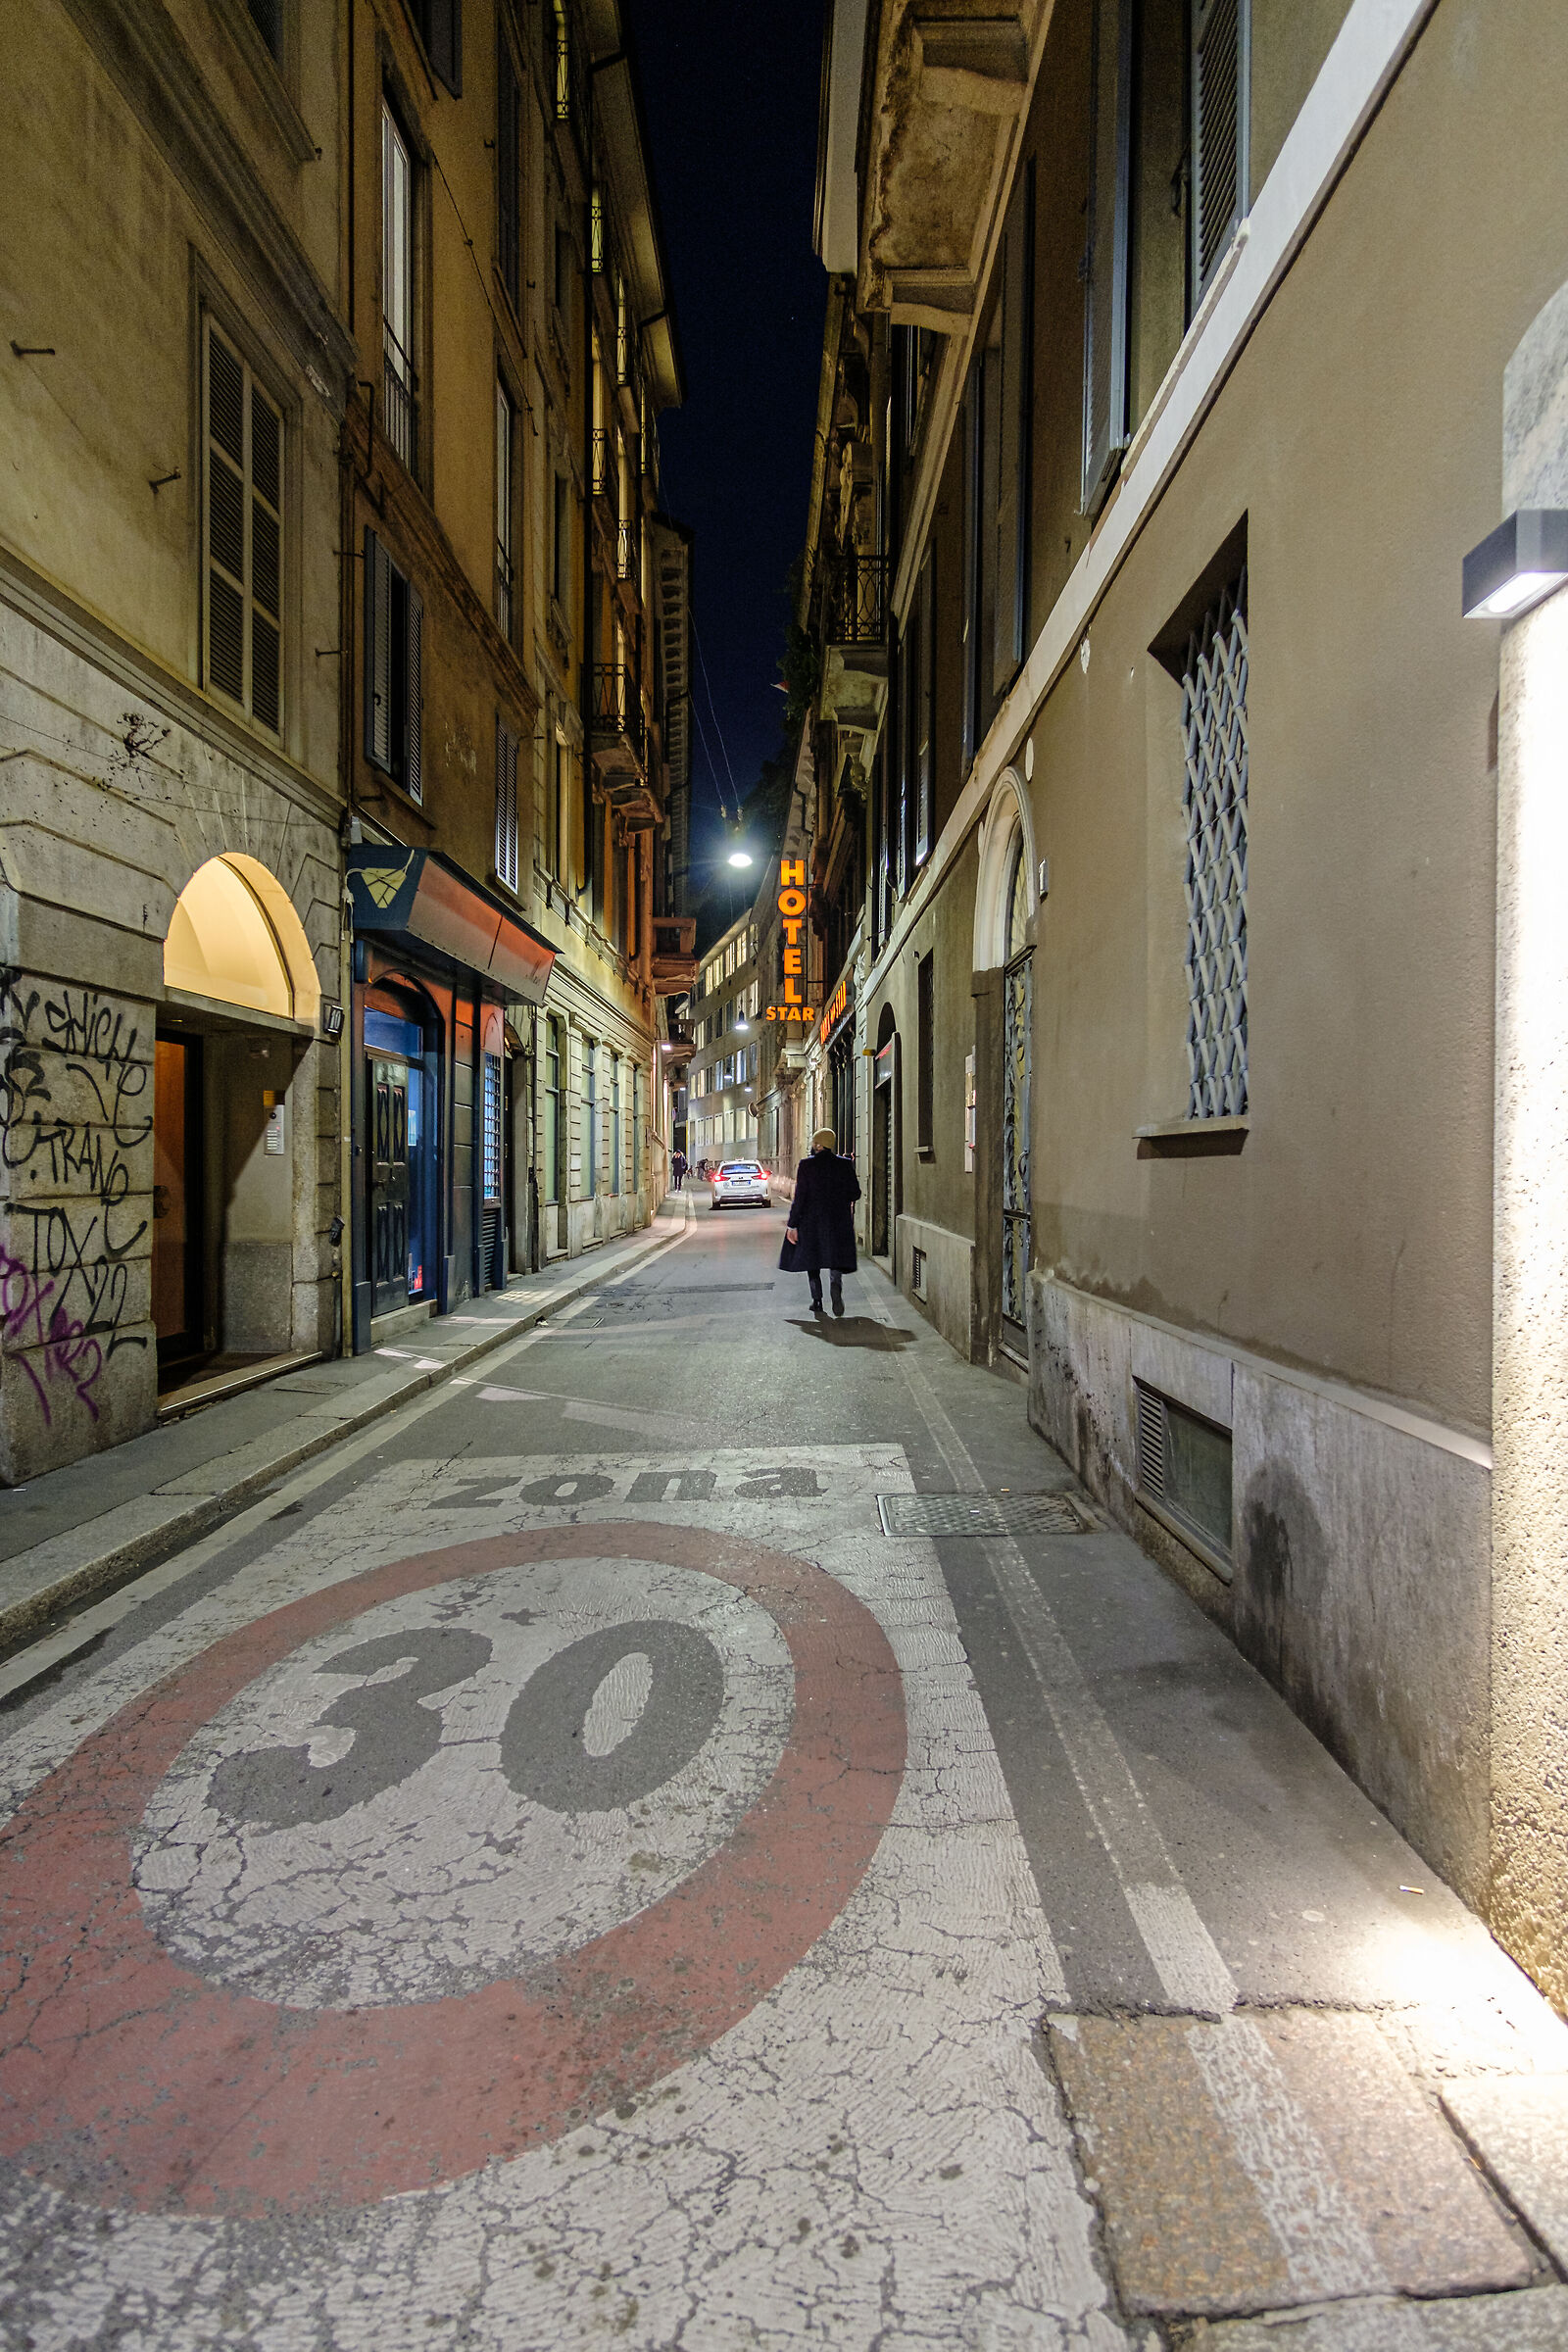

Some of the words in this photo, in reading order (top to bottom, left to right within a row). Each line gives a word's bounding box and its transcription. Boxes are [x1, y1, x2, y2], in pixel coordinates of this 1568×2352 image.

[778, 859, 807, 1004] HOTEL
[329, 1008, 341, 1030] 10
[765, 1005, 814, 1021] STAR
[425, 1466, 829, 1510] zona
[205, 1617, 726, 1836] 30
